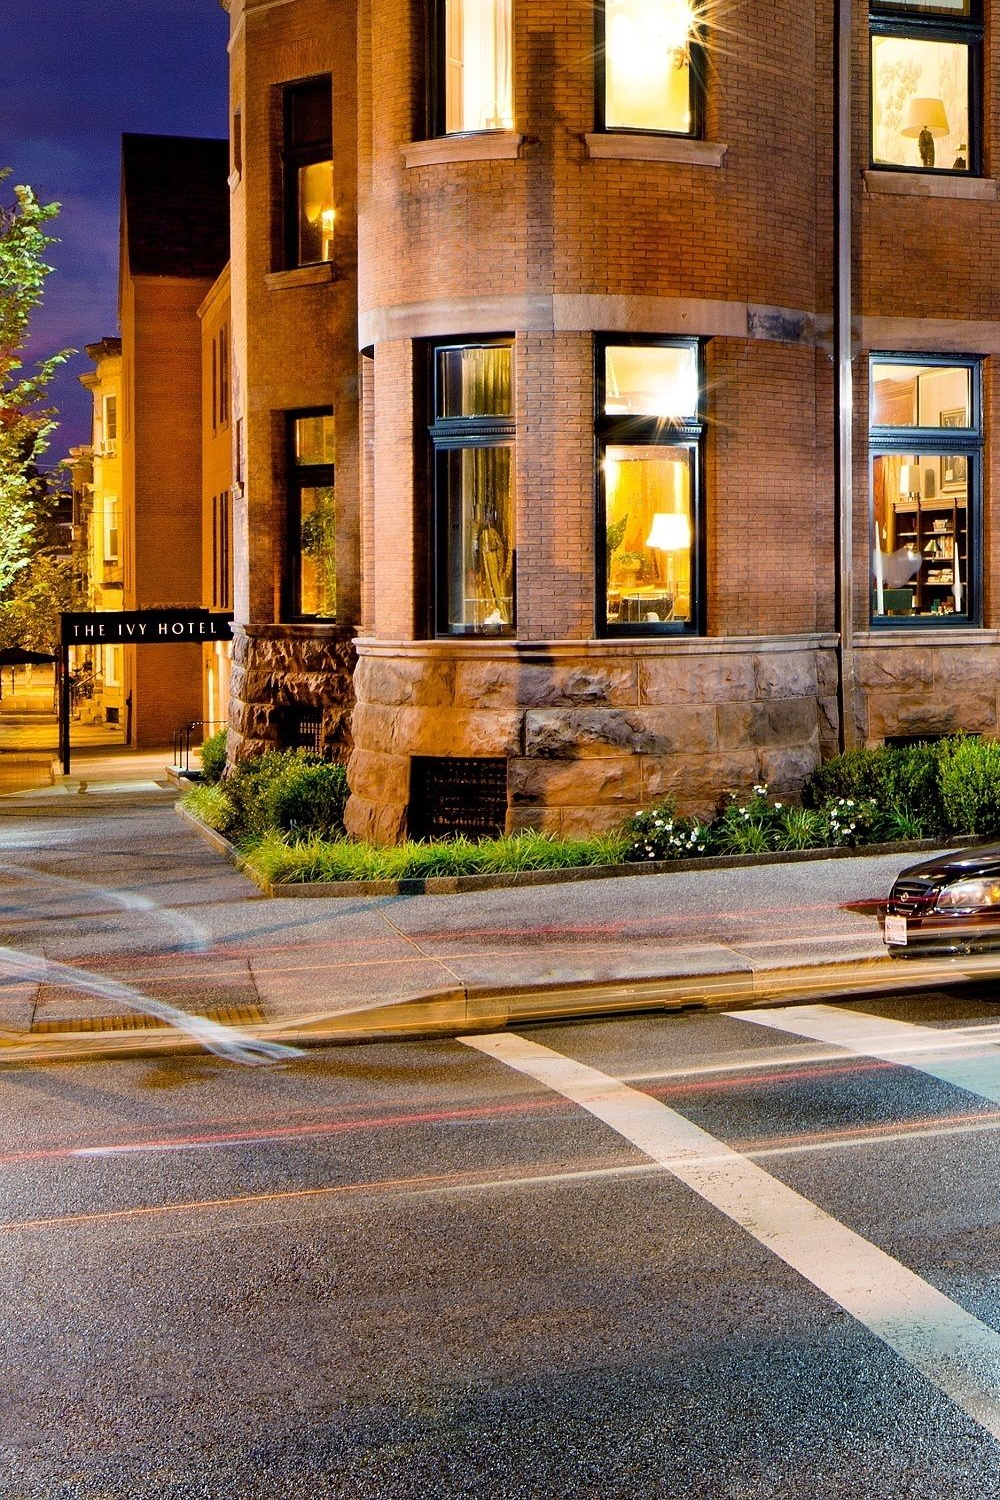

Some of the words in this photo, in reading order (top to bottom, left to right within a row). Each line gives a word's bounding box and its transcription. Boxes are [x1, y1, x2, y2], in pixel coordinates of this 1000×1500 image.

[73, 624, 106, 637] THE
[118, 623, 147, 636] IVY
[158, 622, 217, 635] HOTEL
